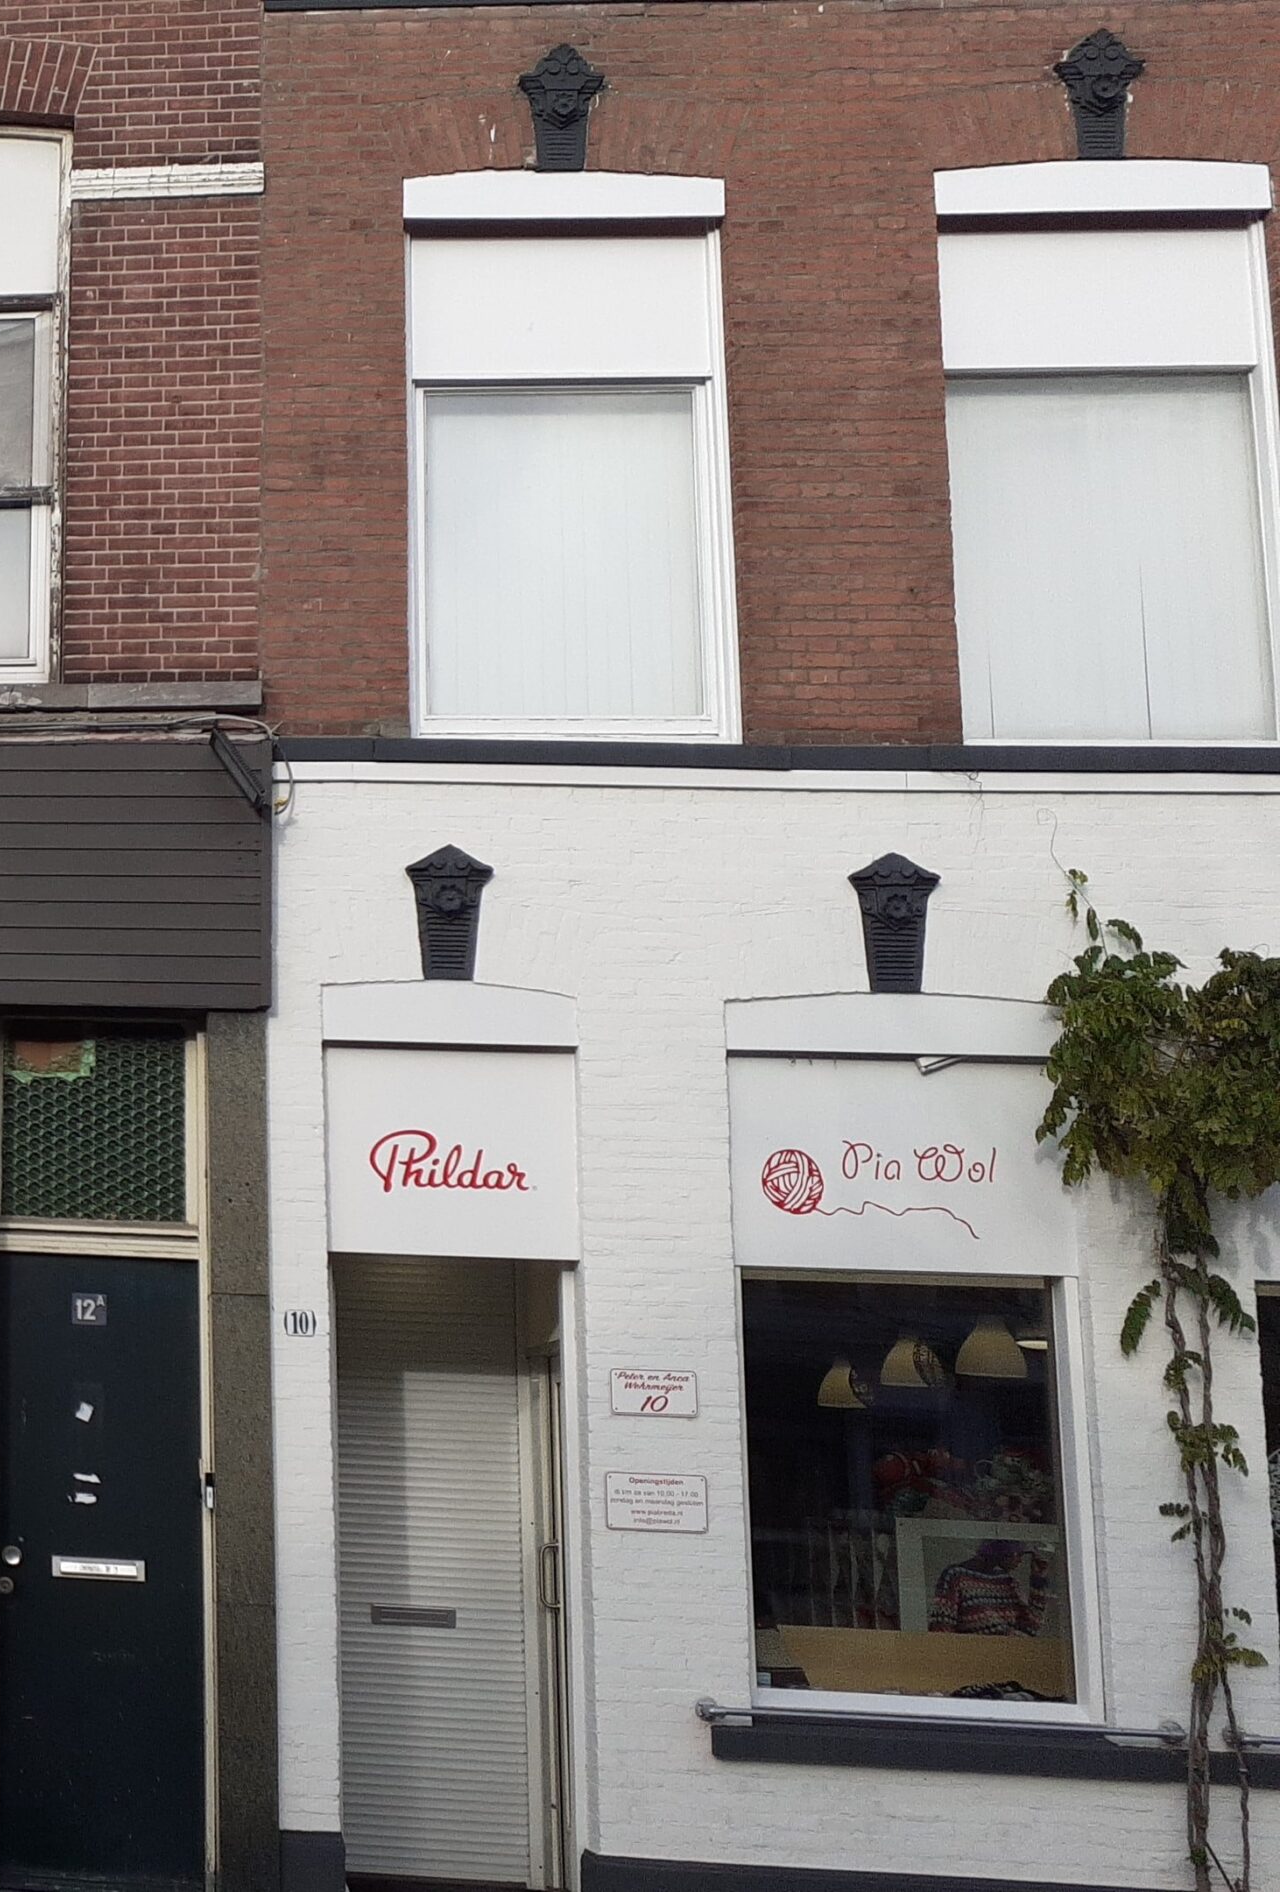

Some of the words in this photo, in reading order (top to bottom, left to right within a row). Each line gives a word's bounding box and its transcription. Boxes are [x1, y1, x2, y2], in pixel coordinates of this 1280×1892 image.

[369, 1129, 529, 1193] Phildar
[841, 1140, 901, 1181] Pia
[913, 1144, 996, 1183] Wol
[290, 1310, 310, 1335] 10
[640, 1395, 669, 1412] 10
[628, 1476, 684, 1486] Openingstijden
